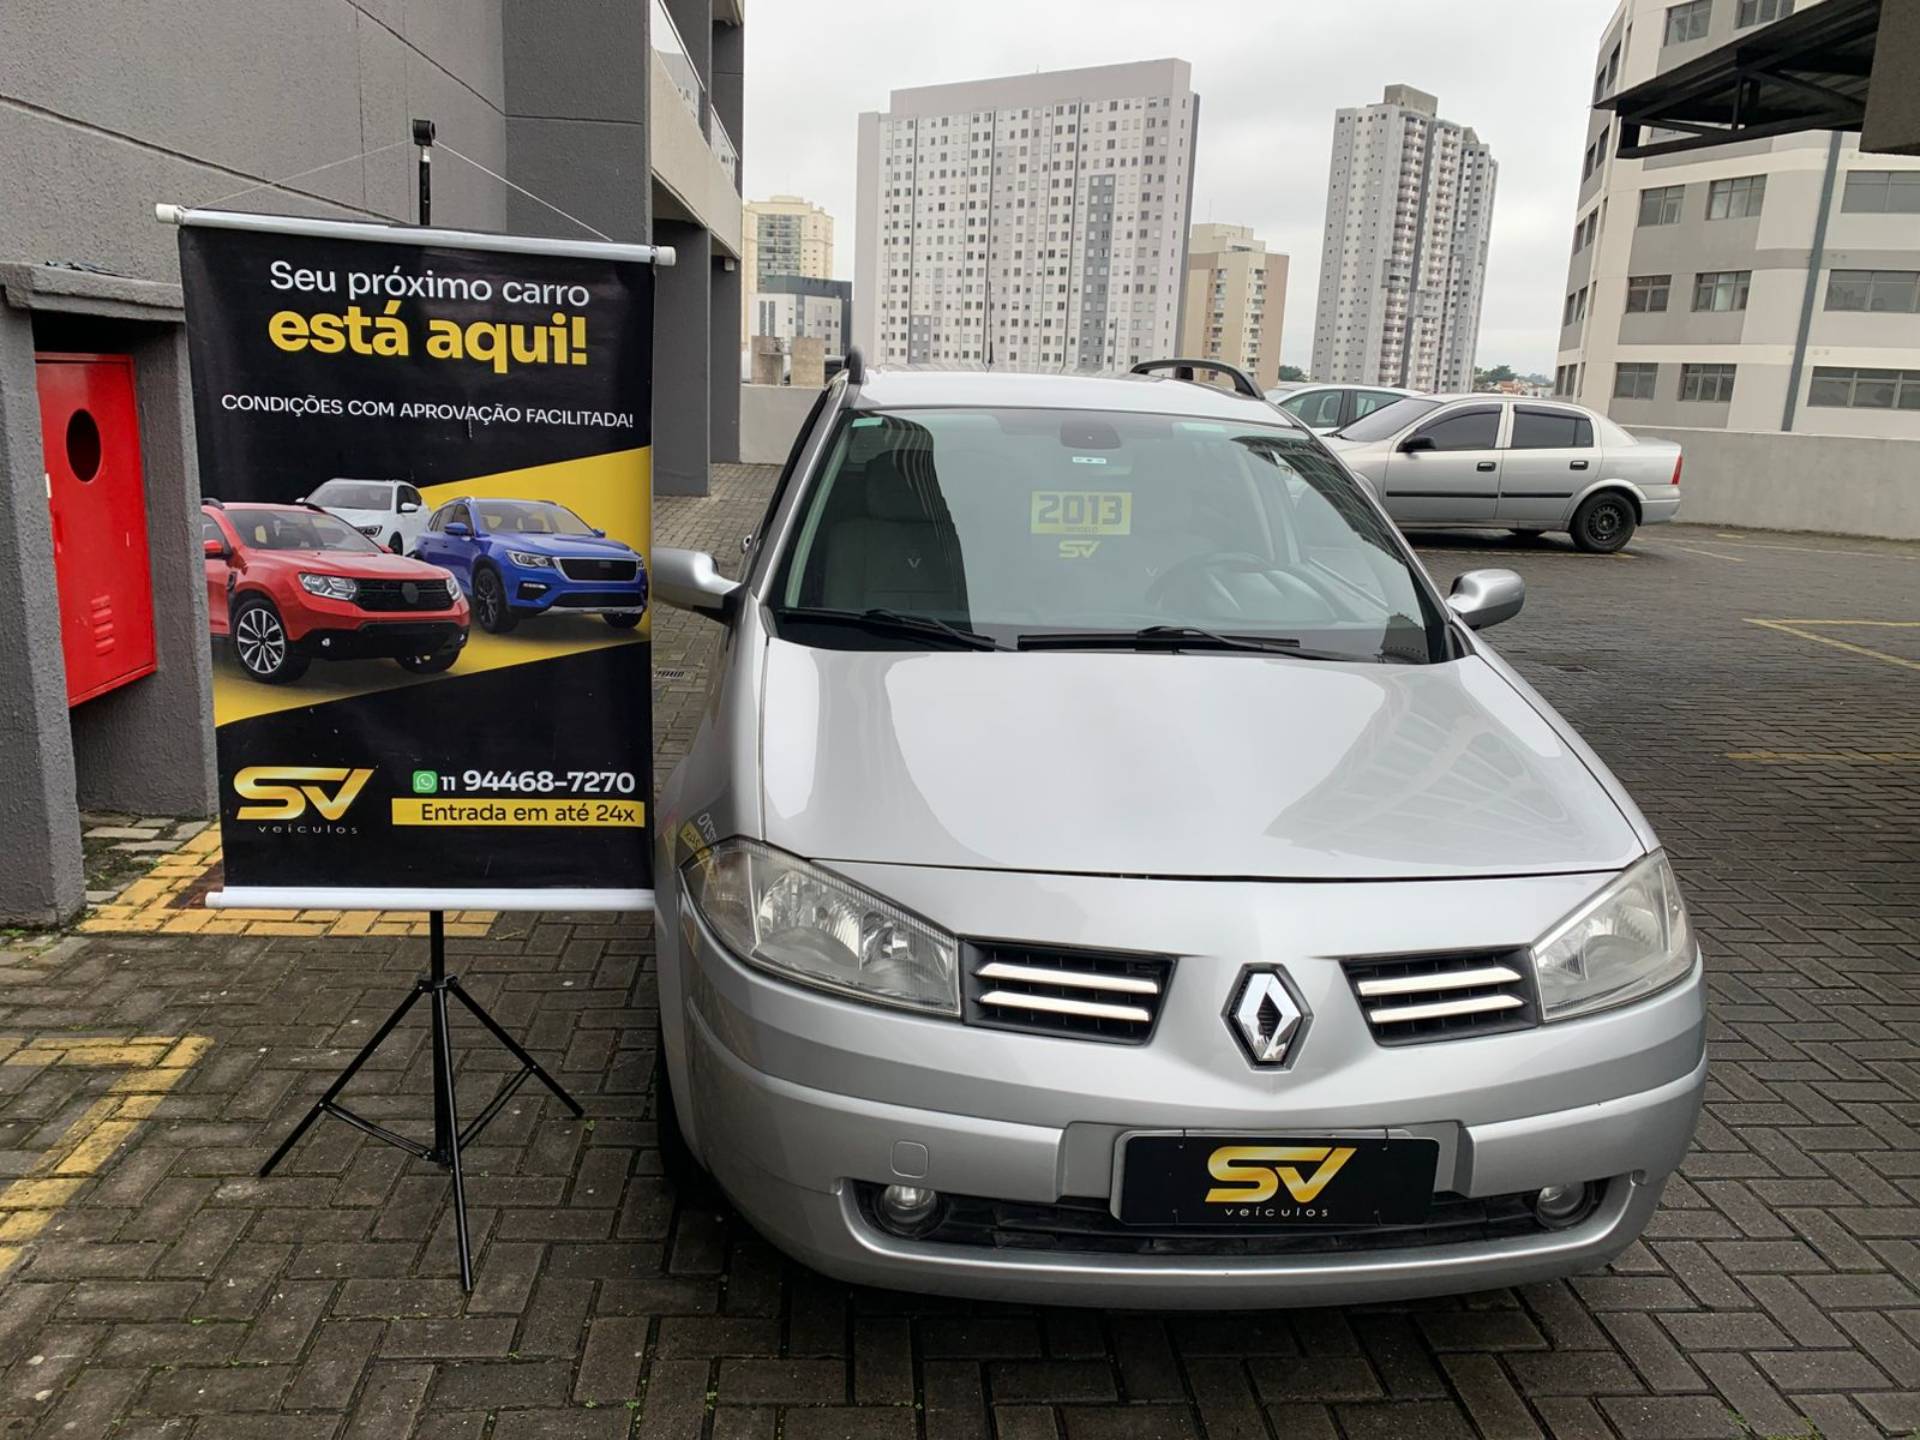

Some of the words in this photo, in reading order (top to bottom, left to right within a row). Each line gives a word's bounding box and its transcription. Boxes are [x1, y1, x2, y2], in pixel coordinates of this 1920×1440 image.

[269, 259, 336, 293] Seu
[347, 264, 492, 301] próximo
[502, 280, 590, 306] carro
[268, 299, 409, 356] está
[426, 311, 588, 374] aqui!
[221, 393, 343, 417] CONDIÇÕES
[348, 399, 395, 417] COM
[400, 402, 522, 425] APROVAÇÃO
[526, 408, 634, 429] FACILITADA!
[1037, 495, 1123, 526] 2013
[232, 766, 375, 821] SV
[440, 776, 456, 792] 11
[463, 770, 636, 793] 94468-7270
[421, 803, 507, 822] Entrada
[514, 808, 547, 822] em
[554, 804, 590, 822] até
[596, 806, 635, 822] 24x
[256, 825, 358, 834] veículos
[1204, 1146, 1357, 1202] SV
[1225, 1206, 1329, 1218] veículos
